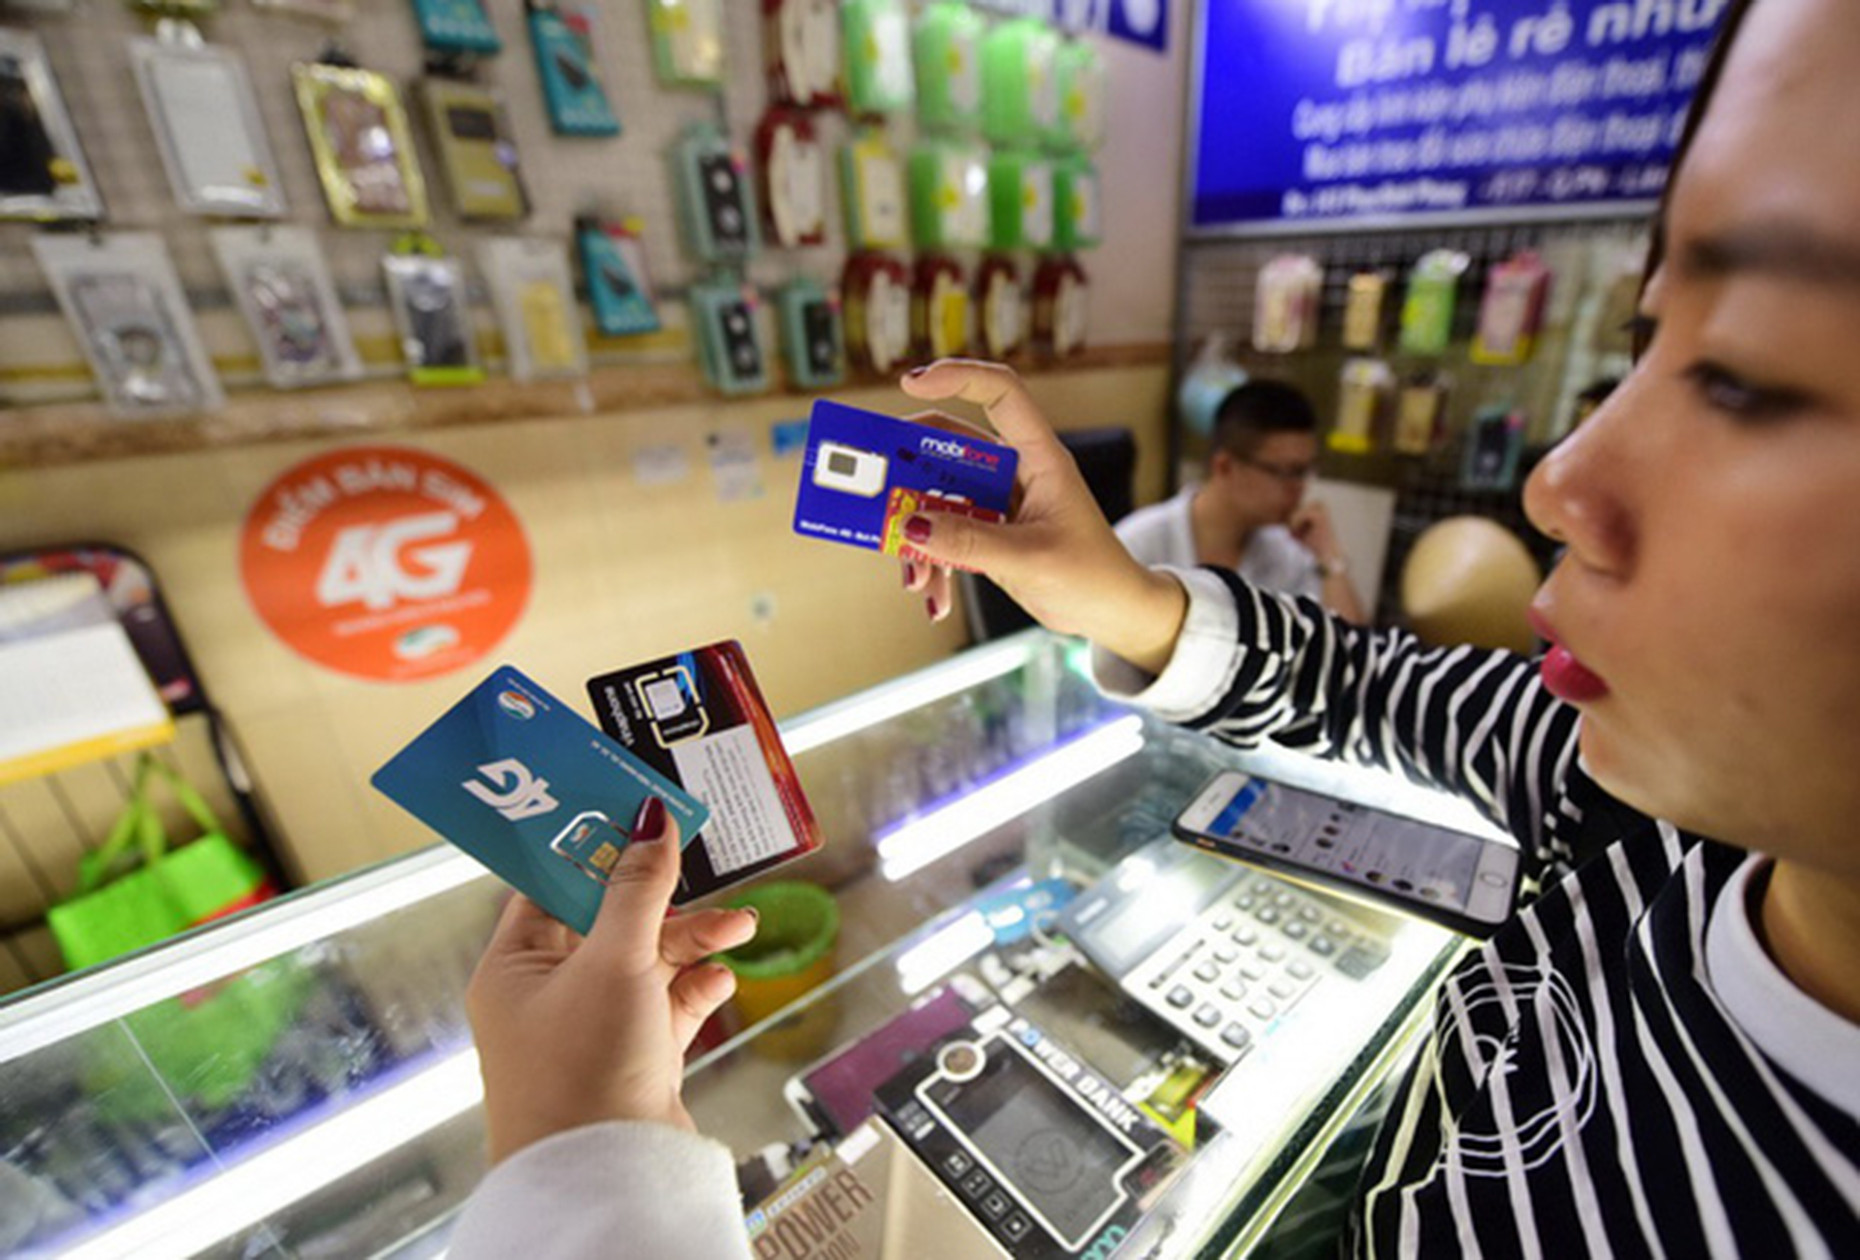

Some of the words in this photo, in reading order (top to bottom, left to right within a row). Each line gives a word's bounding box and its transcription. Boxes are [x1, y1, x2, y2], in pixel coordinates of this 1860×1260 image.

[920, 436, 1000, 464] mobifone
[315, 510, 473, 609] 4G
[461, 757, 560, 822] 4G
[1009, 1017, 1078, 1083] POWER
[1075, 1071, 1142, 1133] BANK
[753, 1168, 874, 1260] POWER
